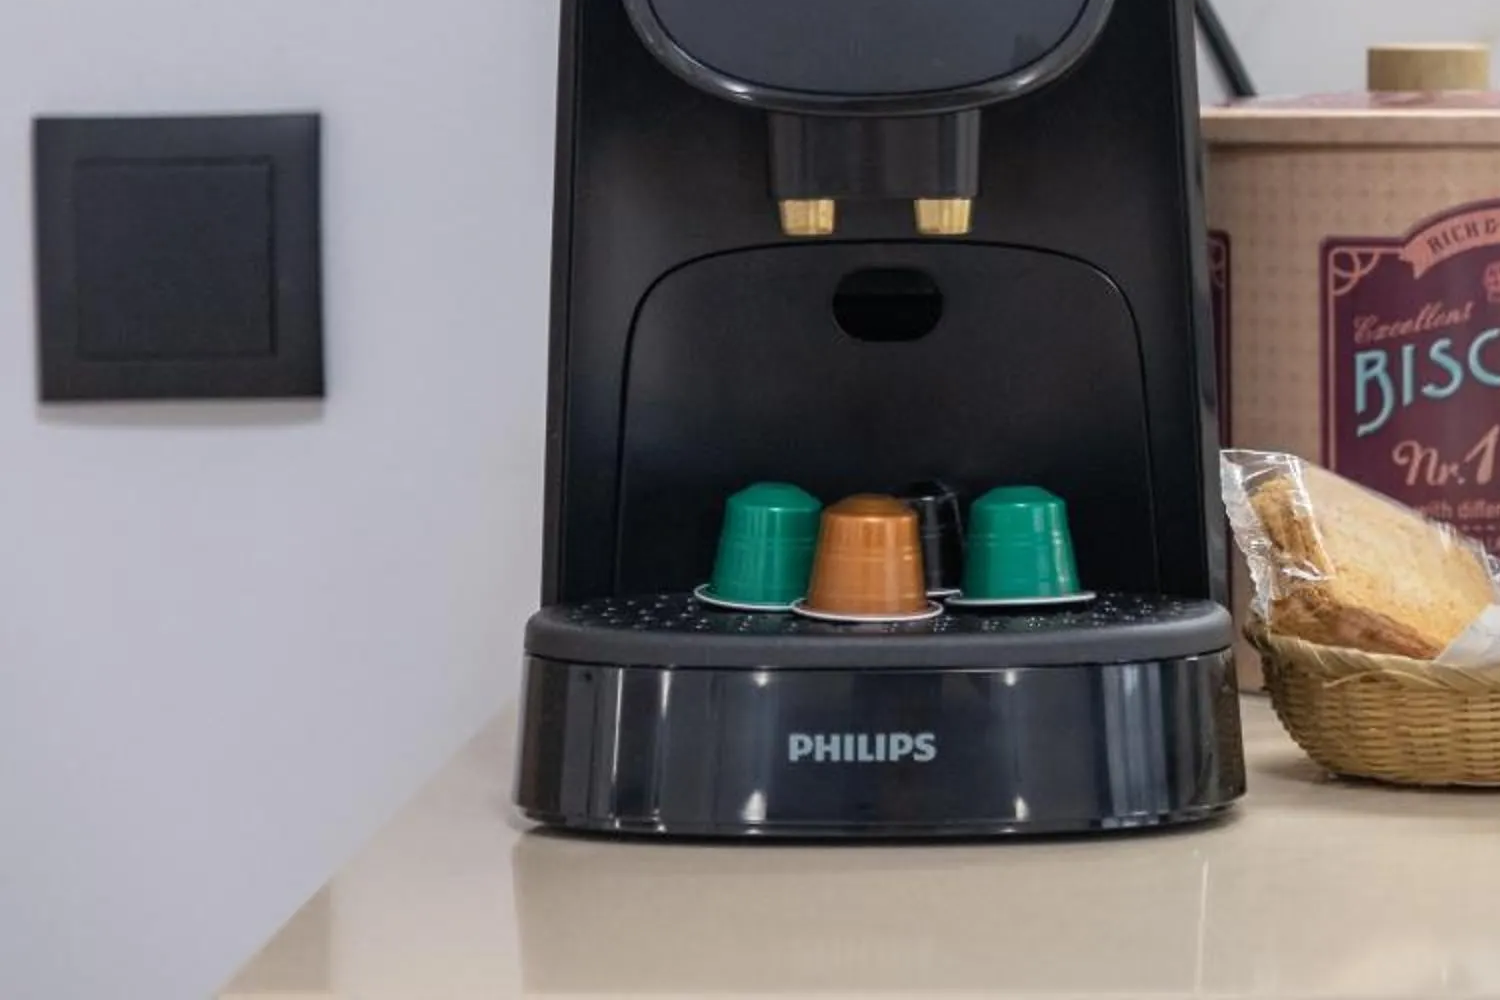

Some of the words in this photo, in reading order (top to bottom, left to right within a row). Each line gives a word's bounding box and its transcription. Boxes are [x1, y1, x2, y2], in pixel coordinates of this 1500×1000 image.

[1427, 219, 1480, 254] RICH
[1353, 301, 1475, 344] Excellent
[787, 732, 938, 763] PHILIPS
